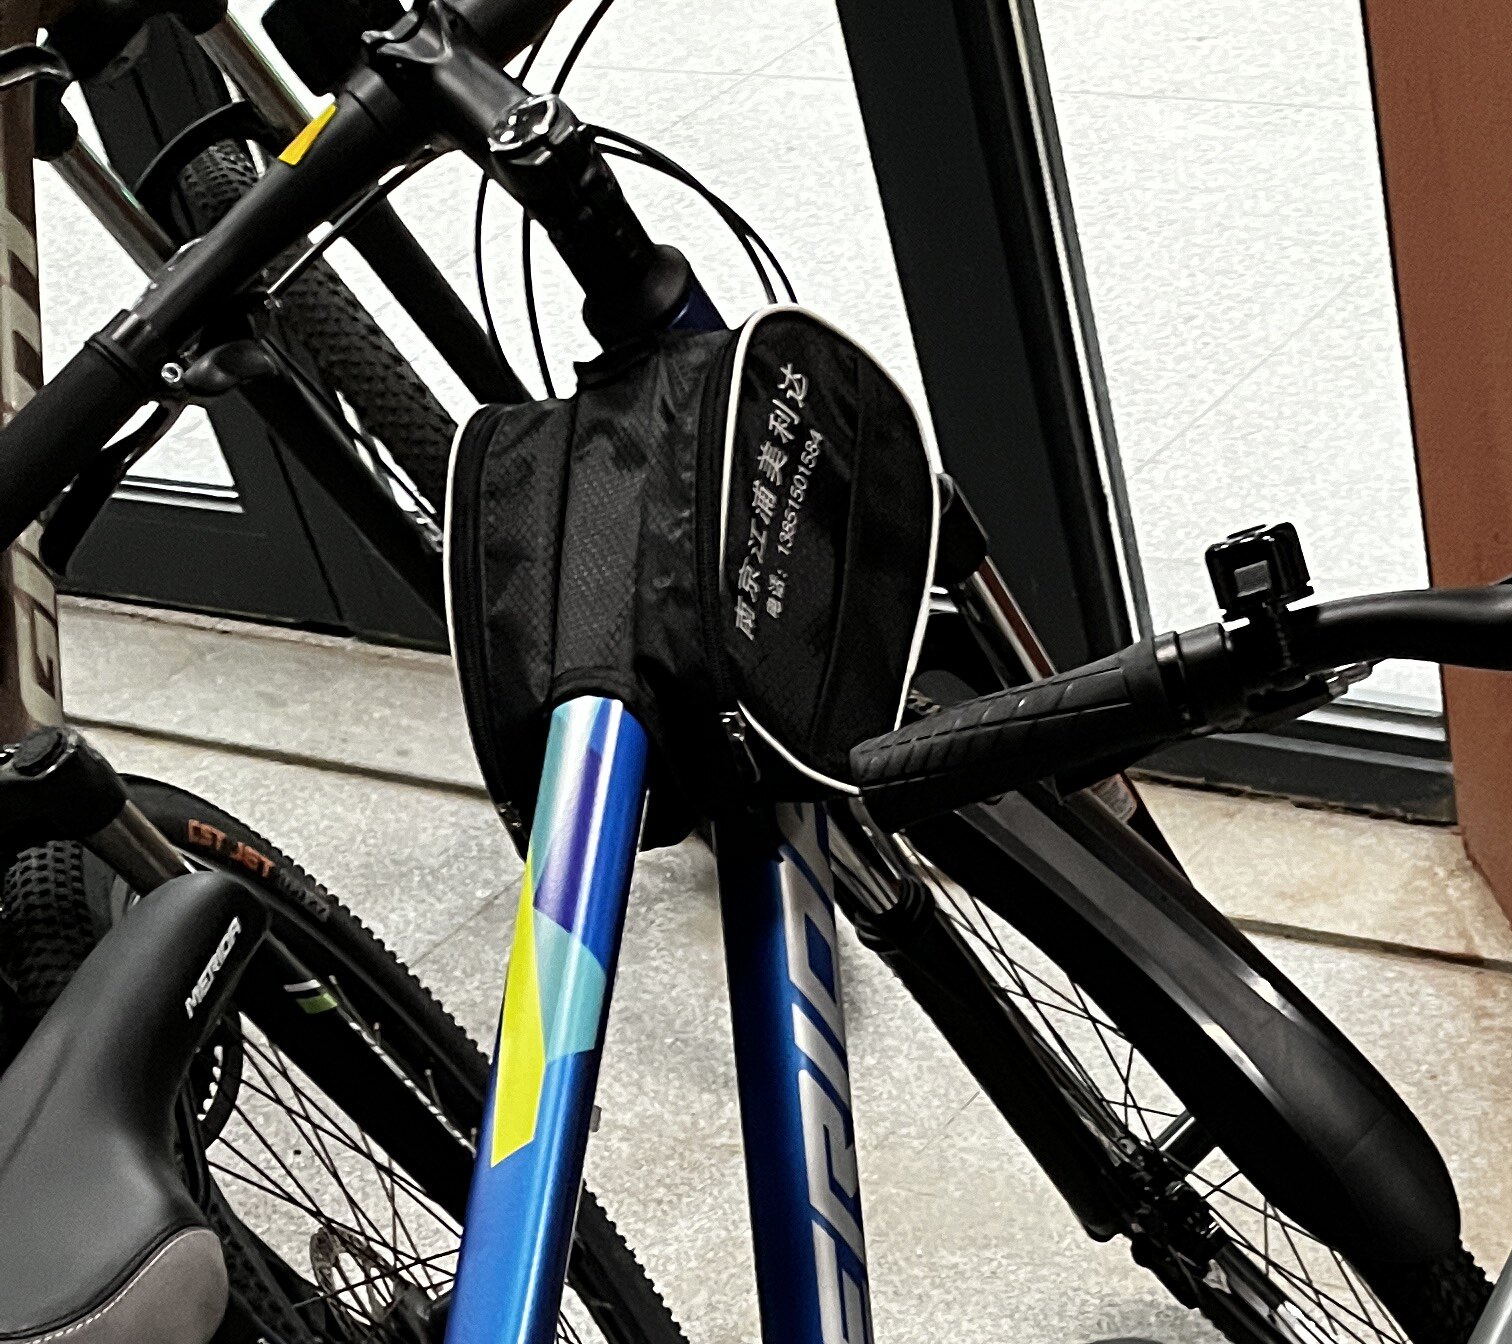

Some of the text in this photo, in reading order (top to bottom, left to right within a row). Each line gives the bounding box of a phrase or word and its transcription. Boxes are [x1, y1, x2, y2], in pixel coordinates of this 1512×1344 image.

[735, 362, 810, 641] 南京江浦美利达
[185, 916, 242, 1020] MERIDA
